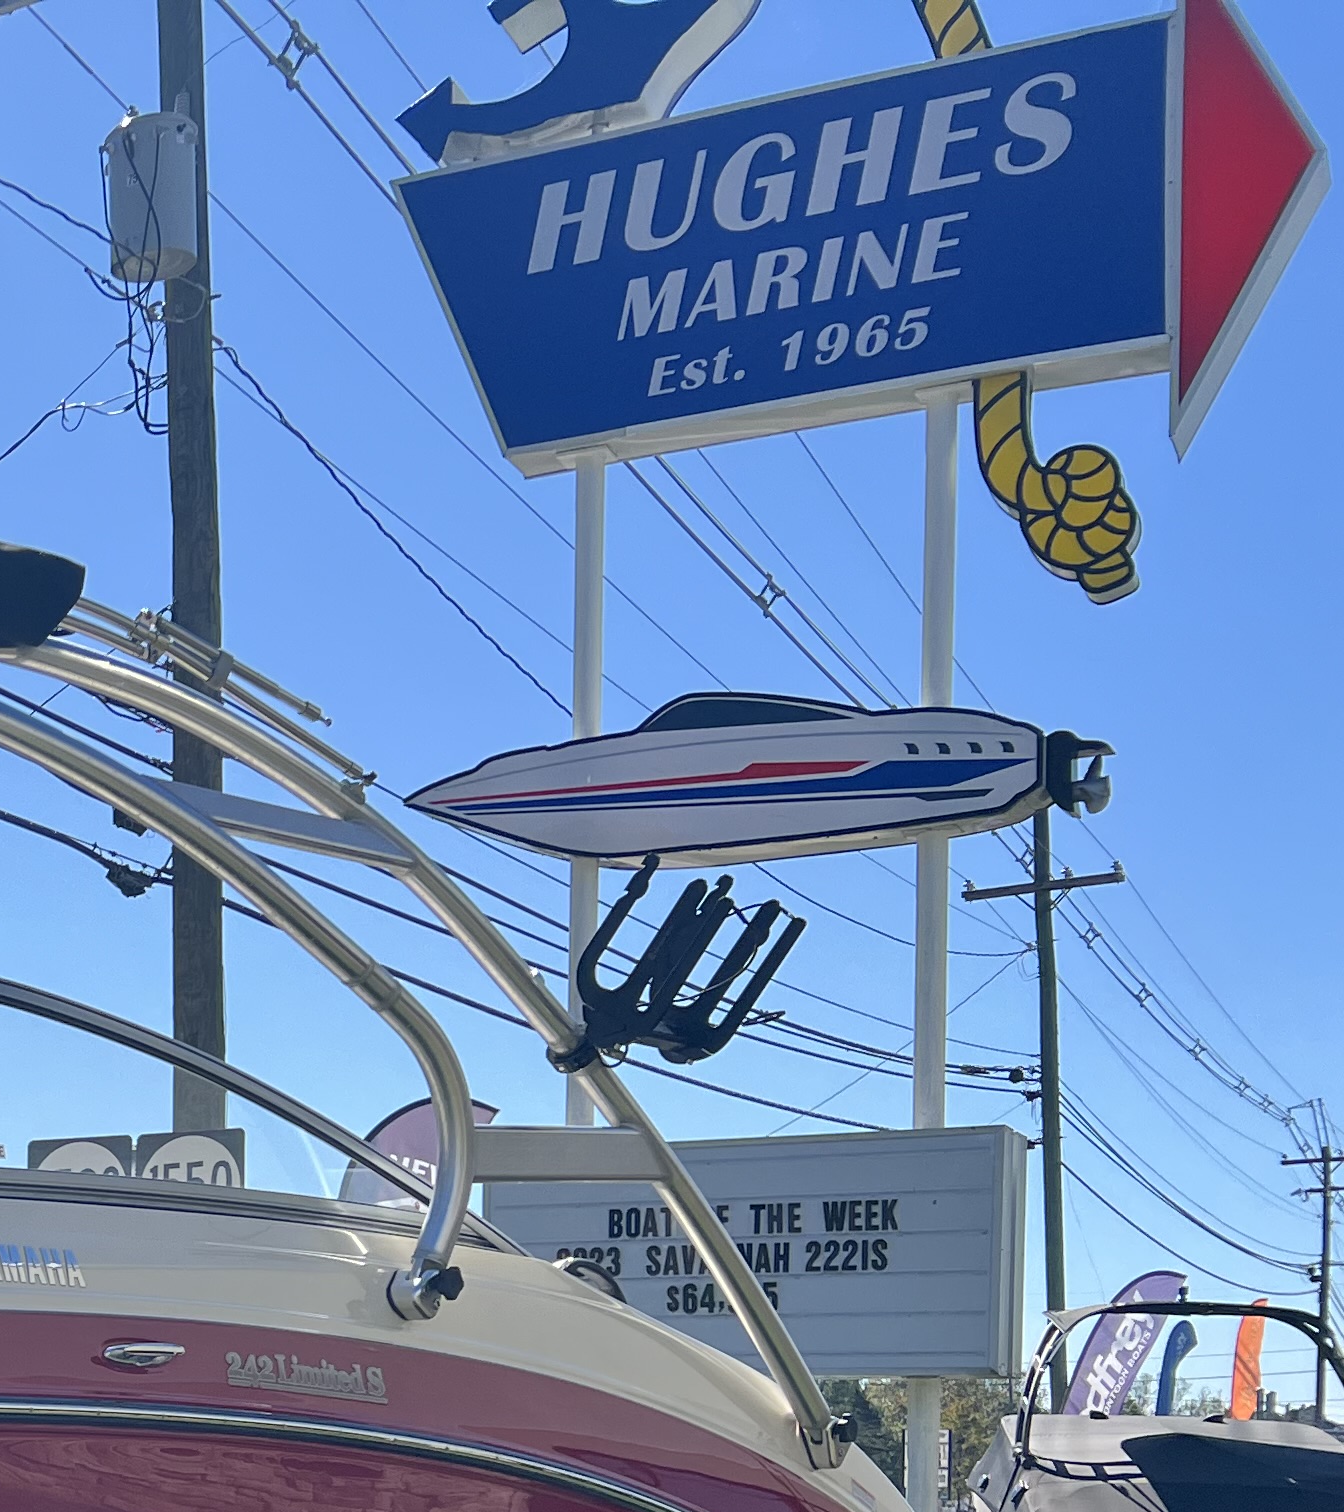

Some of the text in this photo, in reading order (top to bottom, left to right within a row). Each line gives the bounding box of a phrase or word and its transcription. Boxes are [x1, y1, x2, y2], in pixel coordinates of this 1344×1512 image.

[527, 71, 1077, 276] HUGHES
[616, 211, 970, 342] MARINE
[647, 306, 931, 398] Est. 1965
[608, 1207, 673, 1239] BOAT
[749, 1203, 802, 1235] THE
[822, 1199, 899, 1233] WEEK
[646, 1242, 790, 1277] SAVNAH
[666, 1281, 779, 1314] $64,5
[225, 1351, 386, 1397] 242 Limited S
